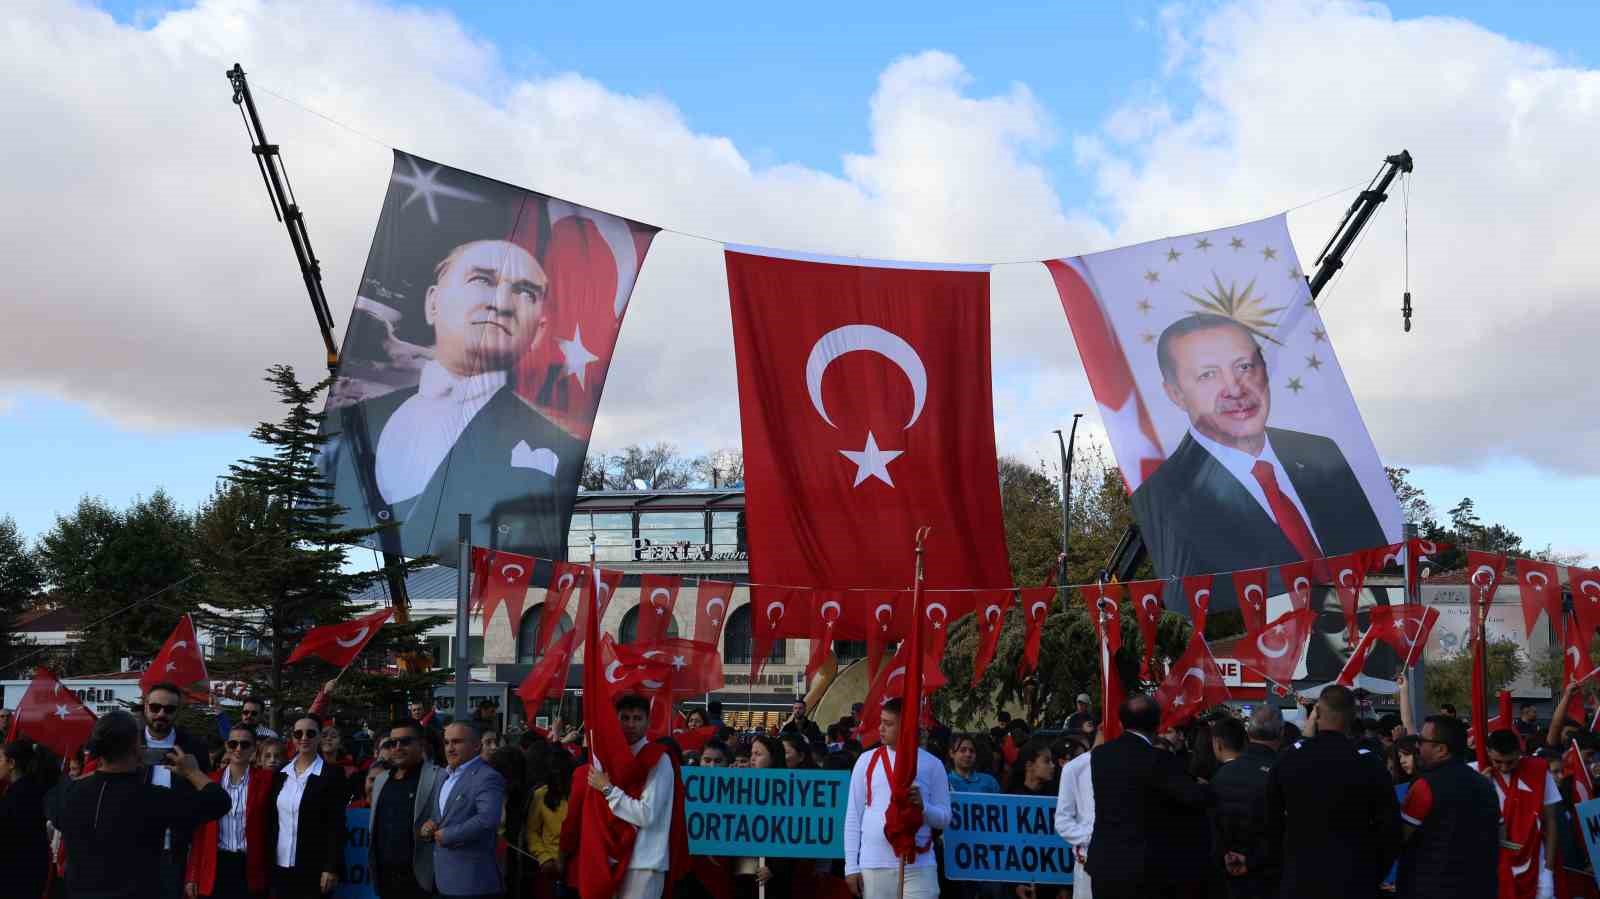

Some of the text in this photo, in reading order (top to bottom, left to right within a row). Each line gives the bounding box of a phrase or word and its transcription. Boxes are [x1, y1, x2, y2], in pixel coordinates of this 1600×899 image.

[1216, 663, 1237, 677] NE
[684, 773, 841, 808] CUMHURİYET
[687, 812, 834, 845] ORTAOKULU
[949, 802, 1009, 833] SIRRI
[955, 842, 1075, 874] ORTAOKU
